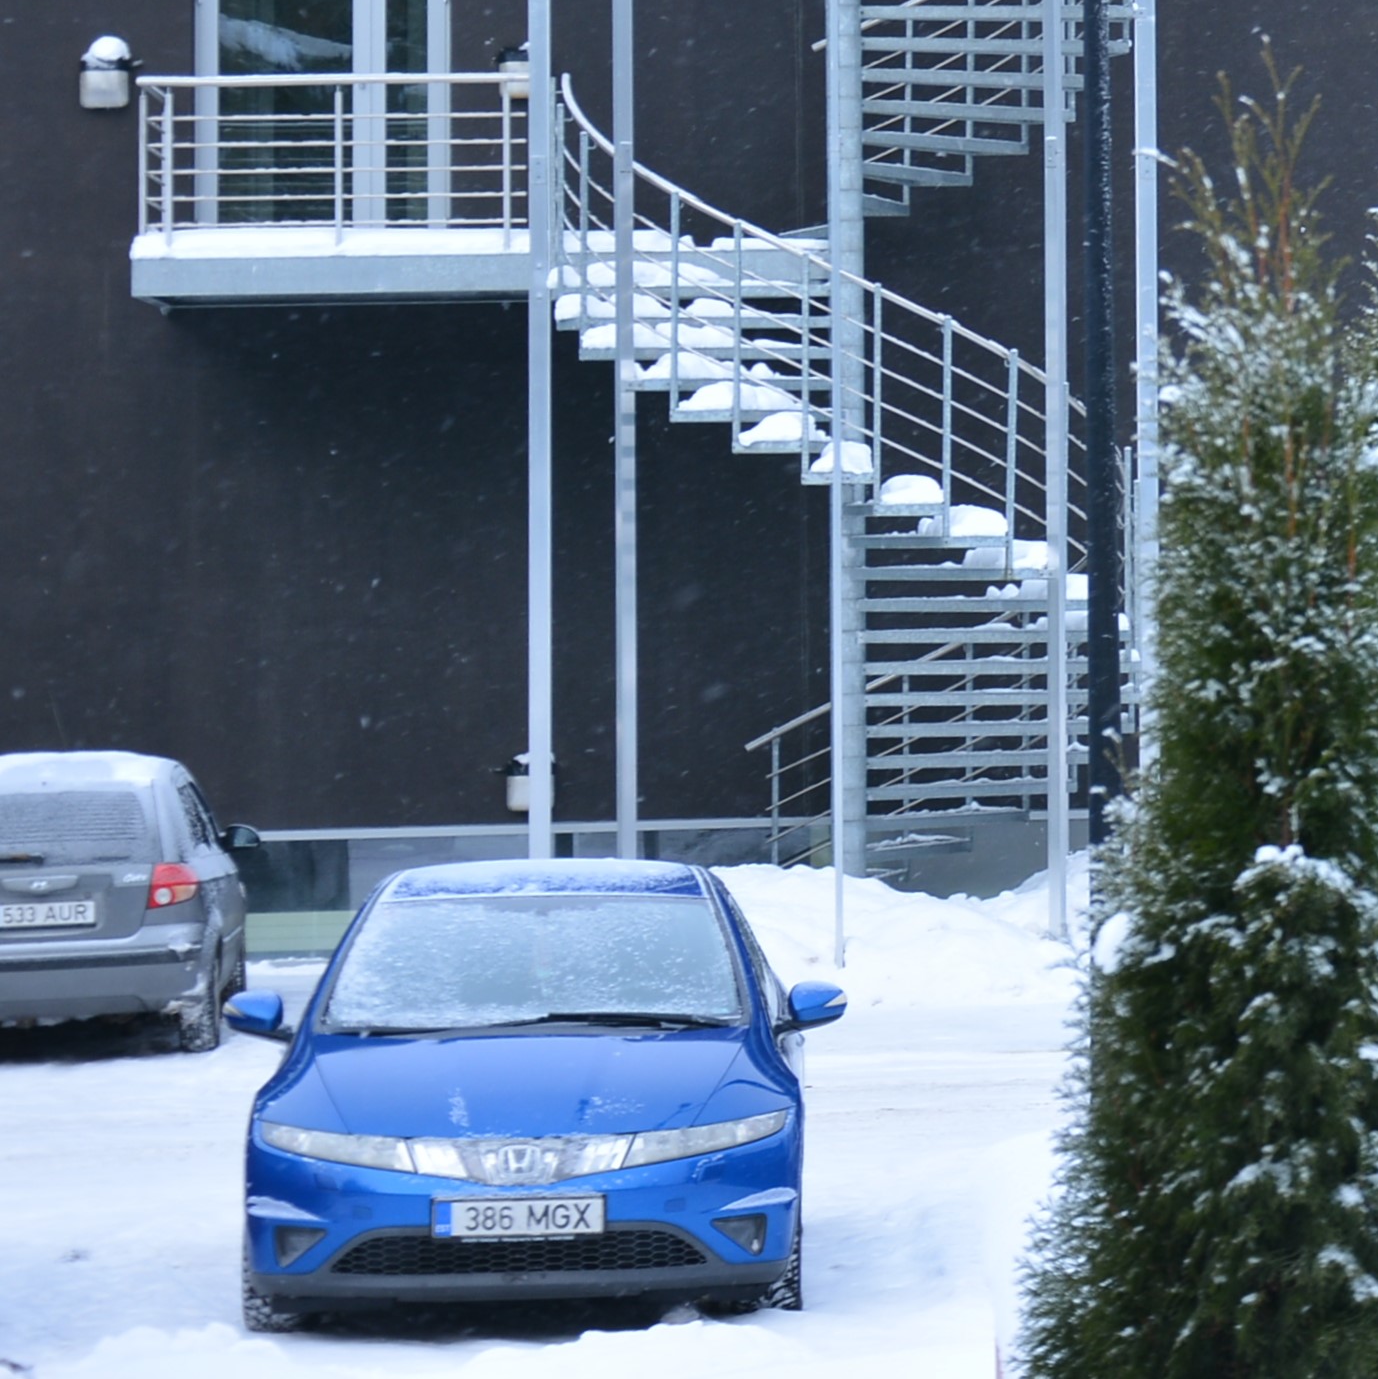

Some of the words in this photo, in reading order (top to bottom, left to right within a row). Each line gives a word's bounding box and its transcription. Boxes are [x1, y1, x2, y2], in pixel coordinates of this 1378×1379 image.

[3, 906, 36, 924] 533
[44, 904, 88, 922] AUR
[465, 1206, 513, 1232] 386
[527, 1203, 591, 1230] MGX
